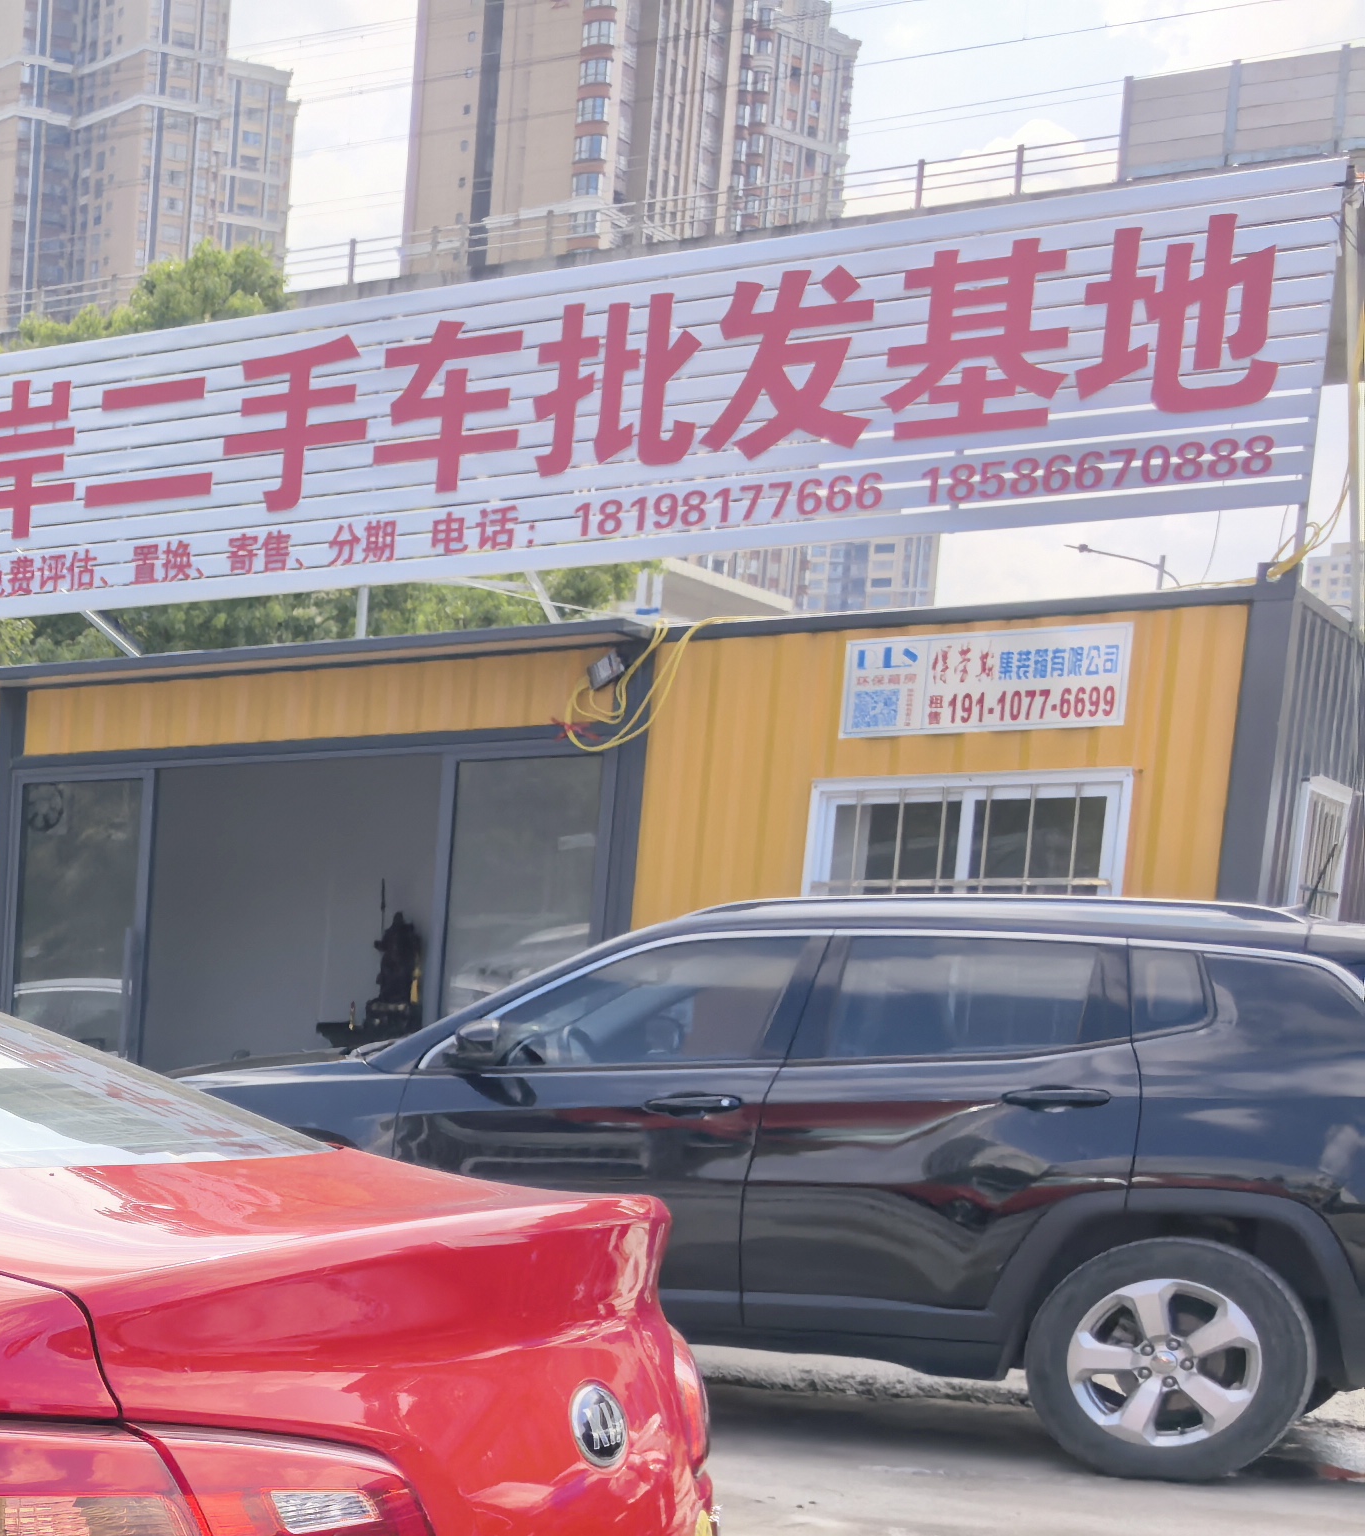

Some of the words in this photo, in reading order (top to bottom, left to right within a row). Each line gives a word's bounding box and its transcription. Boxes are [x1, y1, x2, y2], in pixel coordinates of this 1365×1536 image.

[574, 471, 884, 537] 18198177666
[921, 434, 1275, 505] 18586670888
[947, 685, 1115, 724] 191-1077-6699
